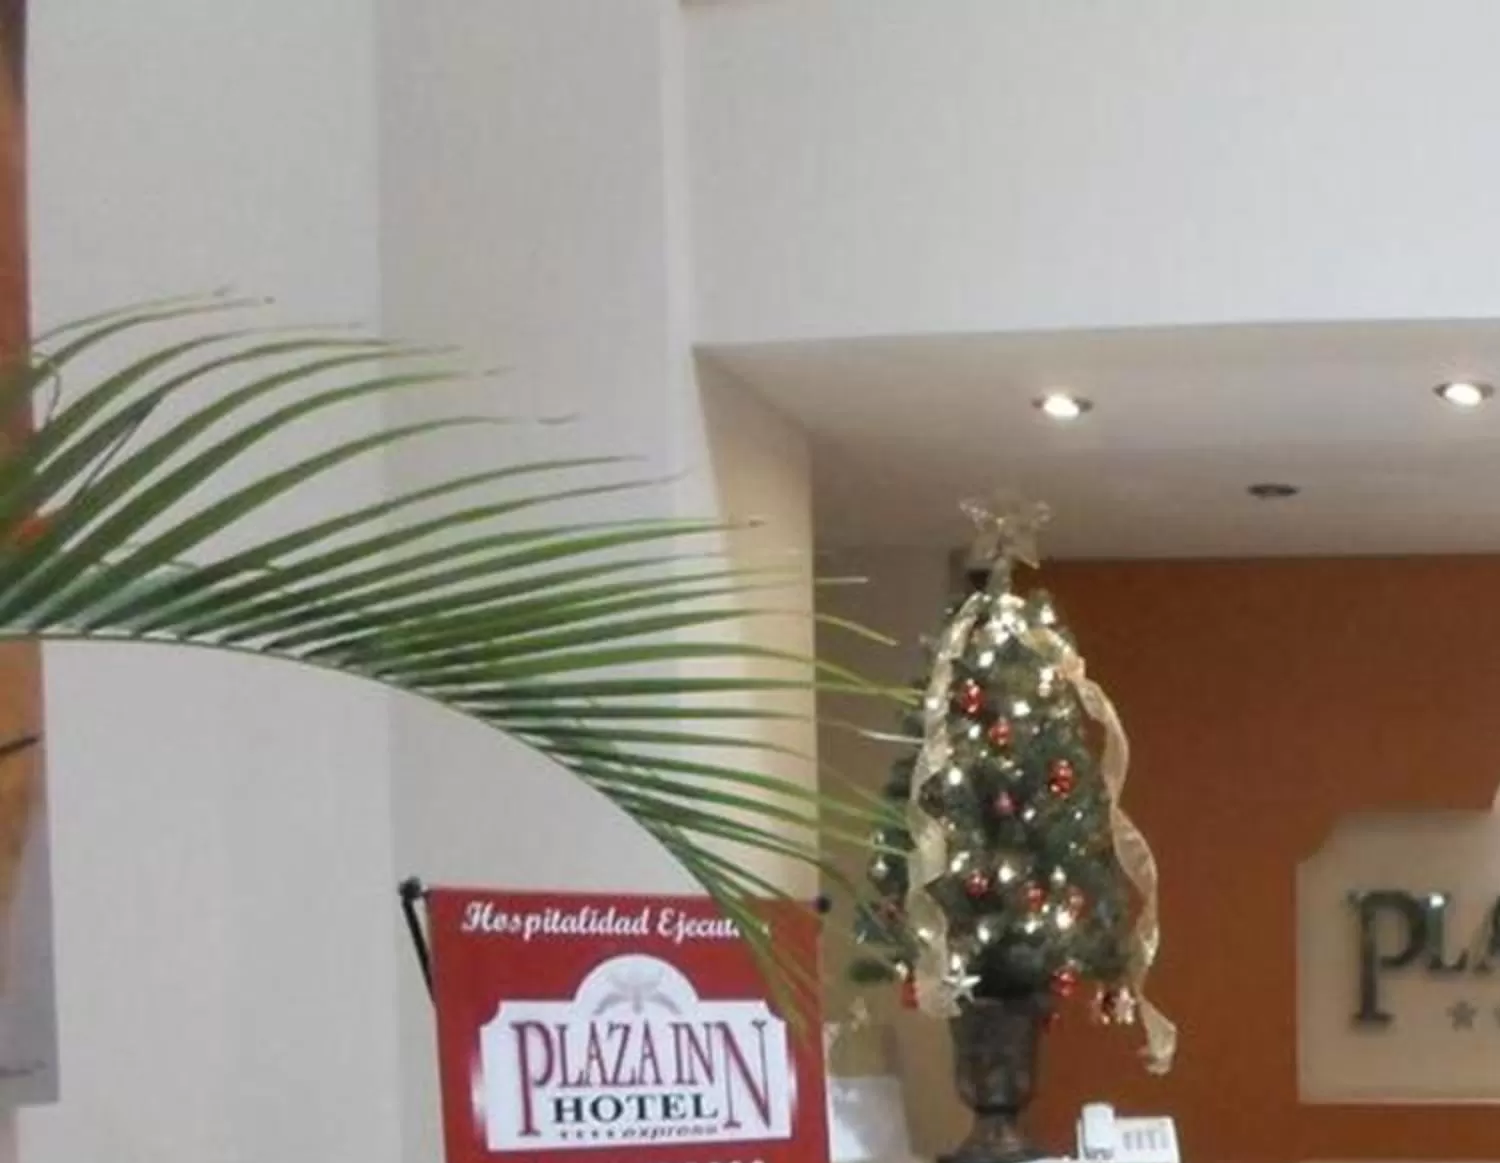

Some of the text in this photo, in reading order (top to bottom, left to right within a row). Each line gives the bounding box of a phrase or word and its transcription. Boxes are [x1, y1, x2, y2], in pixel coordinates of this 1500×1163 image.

[460, 901, 768, 945] Hospitalidad Ejecut
[509, 1018, 772, 1138] PLAZA INN
[553, 1092, 719, 1123] HOTEL
